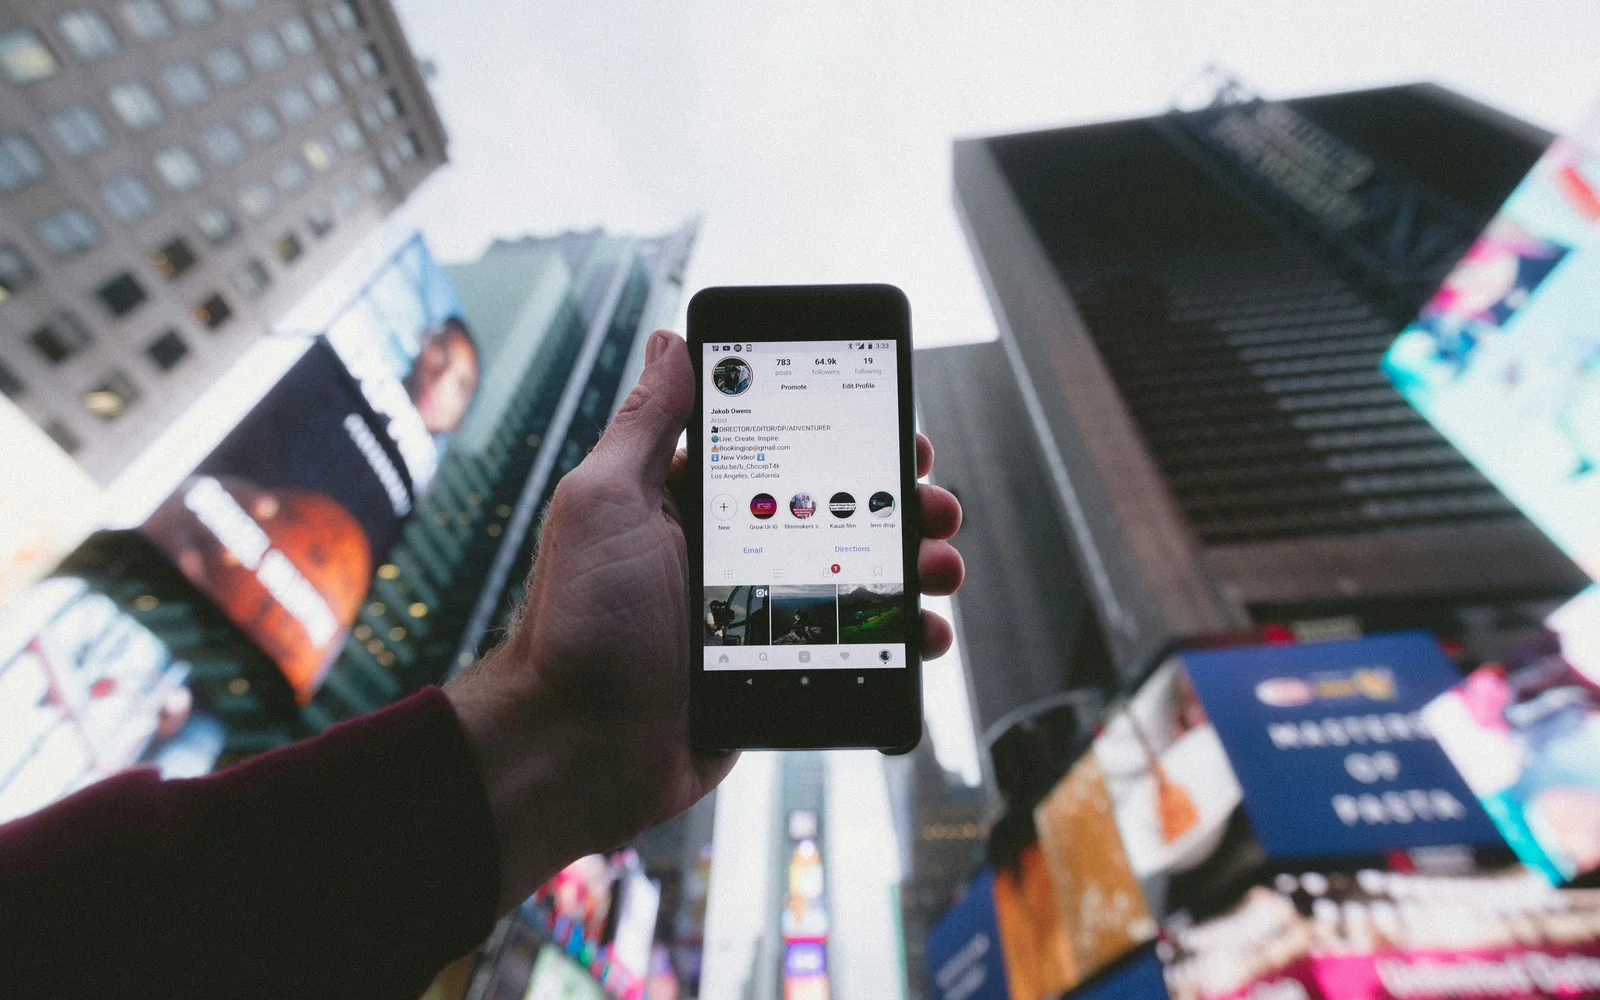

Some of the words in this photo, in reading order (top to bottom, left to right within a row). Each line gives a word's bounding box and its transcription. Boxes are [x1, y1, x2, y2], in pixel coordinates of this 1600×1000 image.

[776, 358, 791, 366] 783
[814, 357, 837, 366] 64.9k
[863, 357, 873, 365] 19
[812, 368, 840, 376] followers
[854, 368, 883, 376] following
[854, 382, 876, 390] Profile
[723, 472, 750, 480] Angeles,
[882, 522, 896, 530] drop
[743, 546, 763, 554] Email
[834, 545, 871, 553] Directions
